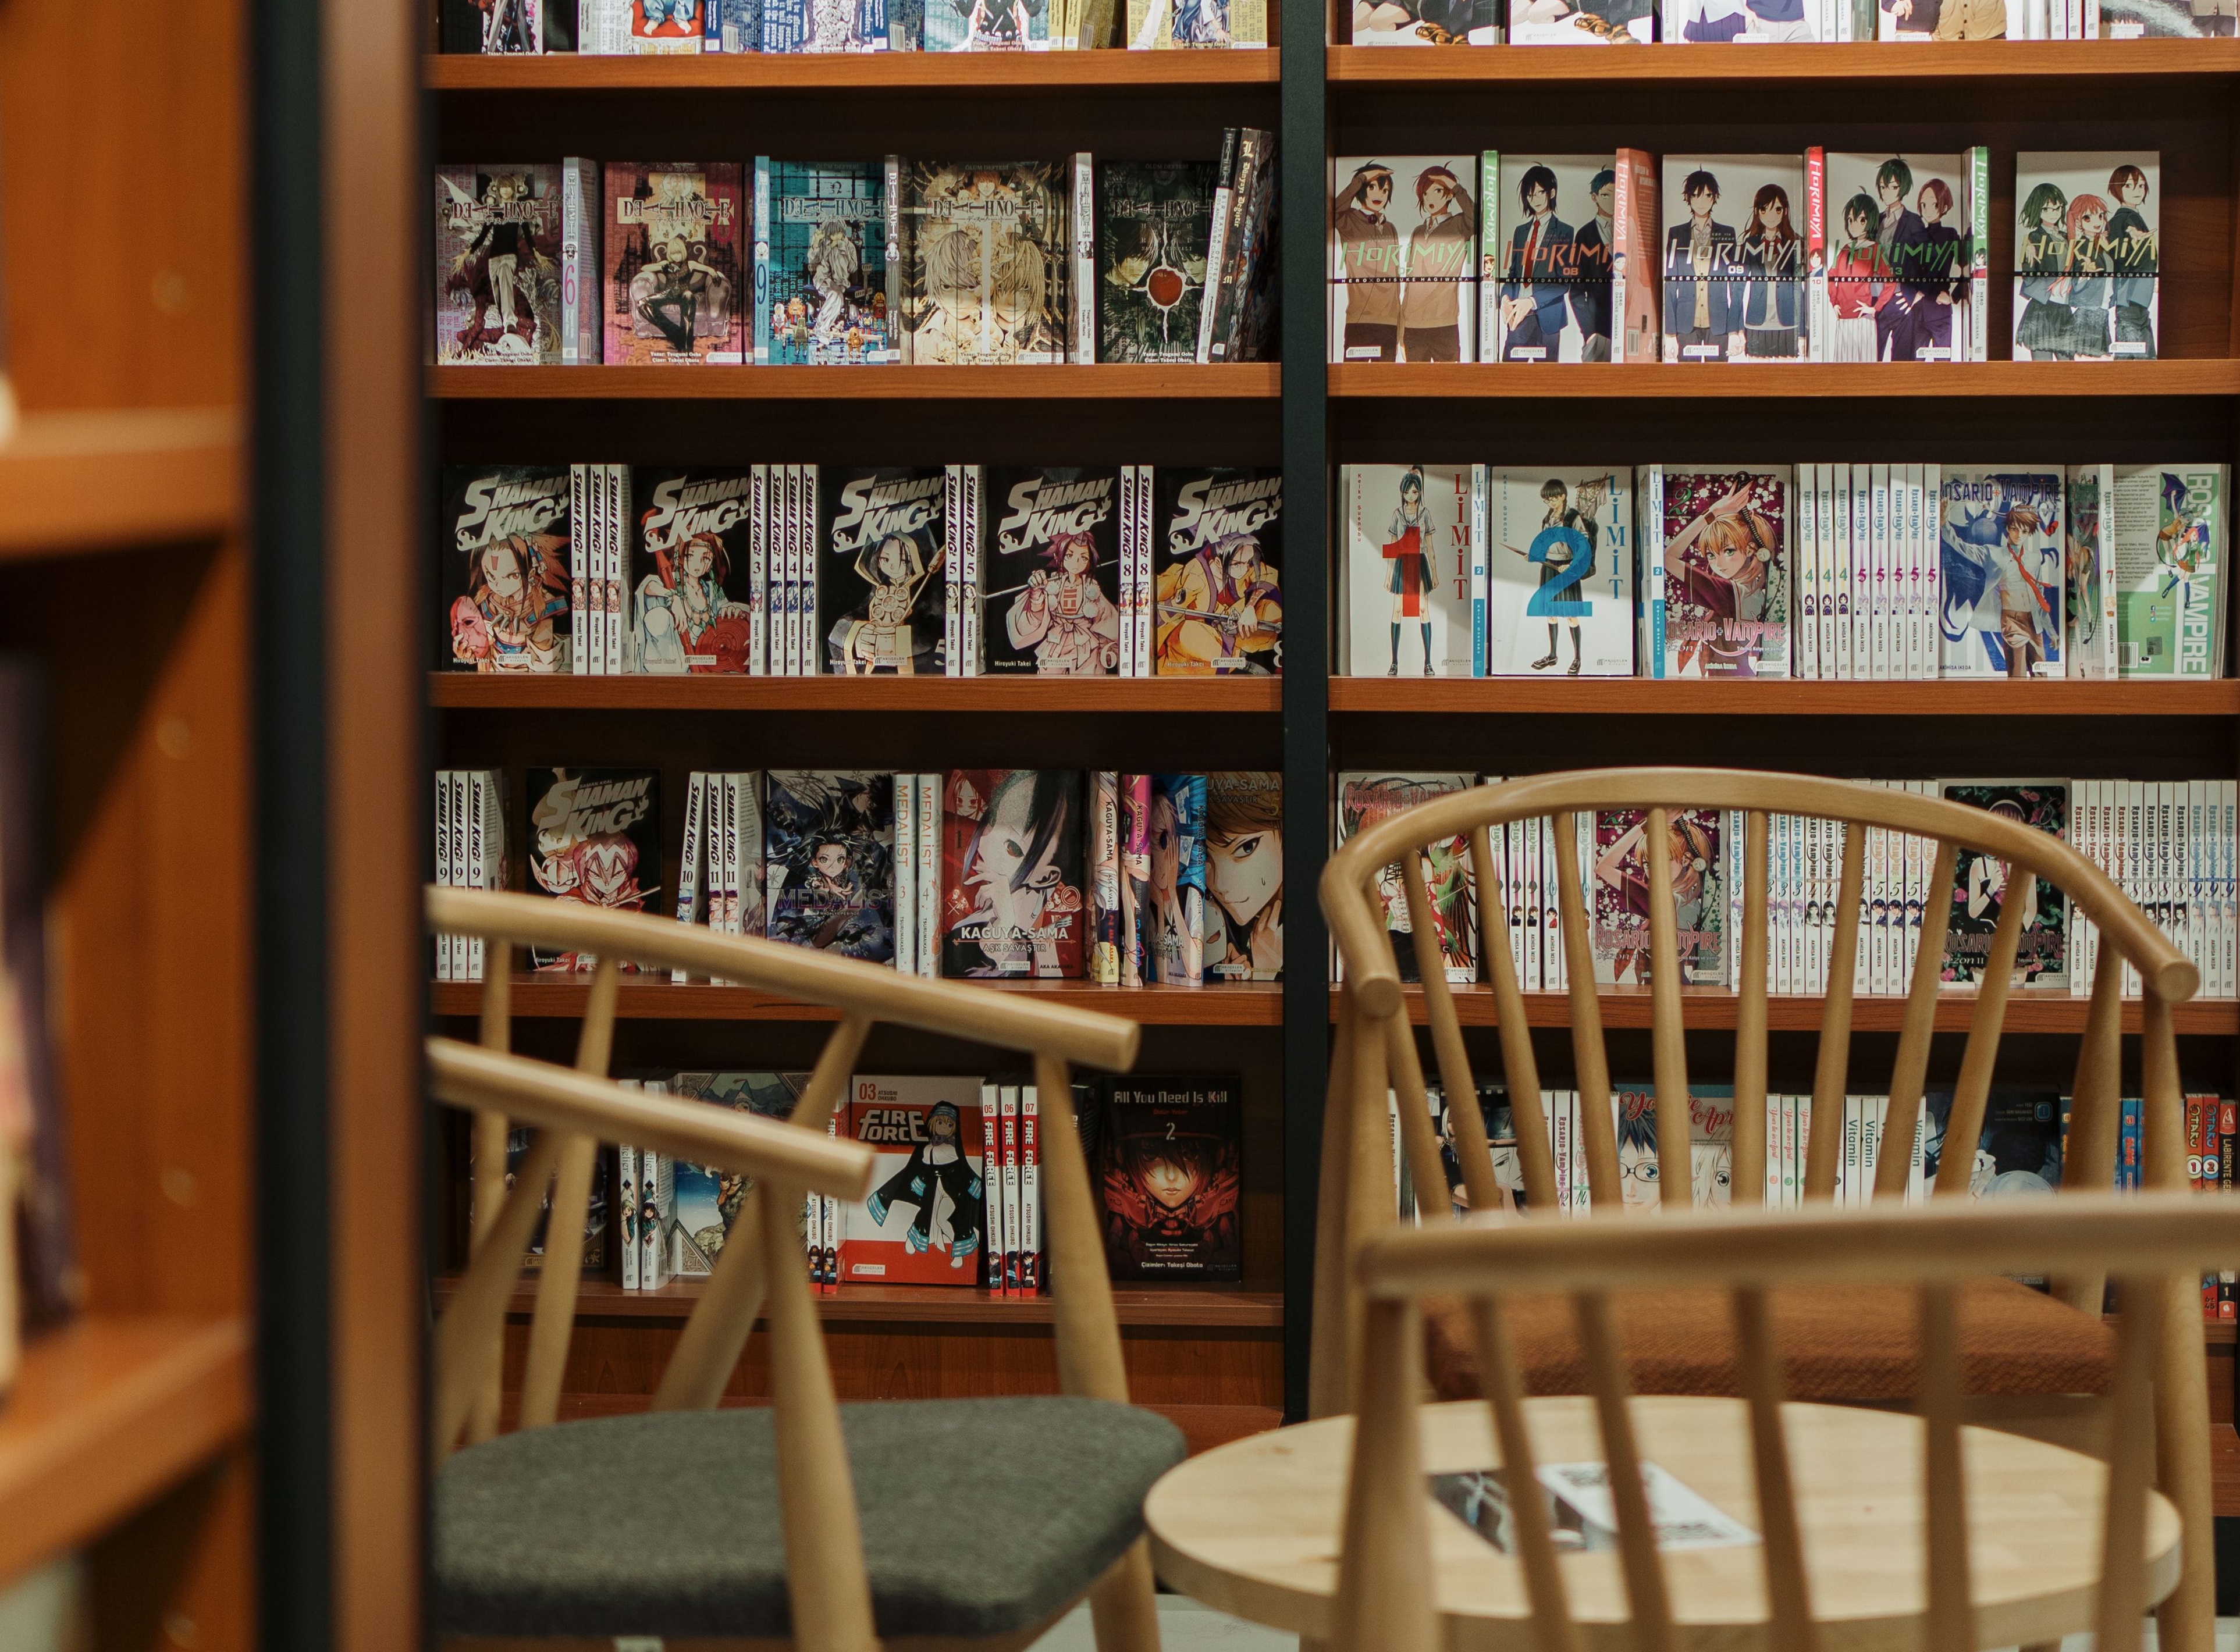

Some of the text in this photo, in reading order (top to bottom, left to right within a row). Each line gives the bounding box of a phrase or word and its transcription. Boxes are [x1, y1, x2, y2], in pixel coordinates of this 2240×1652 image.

[1562, 267, 1578, 276] 08
[1728, 265, 1744, 274] 09
[564, 264, 575, 305] 6
[756, 264, 767, 305] 9
[455, 474, 570, 535] SHAMAN
[831, 474, 945, 535] SHAMAN
[998, 475, 1115, 536] SHAMAN
[469, 496, 566, 547] KING
[657, 498, 750, 549] KING
[845, 497, 943, 549] KING
[1013, 498, 1109, 550] KING
[576, 559, 582, 571] 1
[753, 562, 761, 573] 3
[806, 562, 813, 574] 4
[967, 562, 975, 575] 5
[1123, 564, 1131, 576] 8
[1382, 526, 1420, 617] 1
[1527, 527, 1592, 617] 2
[1839, 568, 1847, 581] 4
[1858, 568, 1866, 582] 5
[2106, 570, 2114, 583] 7
[2182, 576, 2210, 673] VAMPIRE
[1207, 778, 1280, 792] UYA-SAMA
[536, 776, 652, 835] SHAMAN
[550, 799, 646, 848] KING
[1105, 802, 1114, 861] KAGUYA-SAMA
[456, 867, 463, 880] 9
[682, 870, 693, 883] 10
[727, 871, 735, 882] 11
[923, 888, 929, 900] 4
[1808, 883, 1818, 897] 4
[1874, 882, 1886, 896] 5
[2129, 883, 2141, 898] 8
[2206, 882, 2218, 897] 9
[961, 927, 1068, 939] KAGUYA-SAMA
[983, 944, 1046, 953] AŞK SAVAŞTIR
[859, 1083, 876, 1100] 03
[1114, 1091, 1228, 1103] All You Need Is Kill
[984, 1105, 993, 1113] 05
[1005, 1104, 1014, 1113] 06
[1025, 1103, 1034, 1112] 07
[1691, 1106, 1734, 1134] Apr
[1166, 1122, 1175, 1140] 2
[1848, 1120, 1858, 1166] Vitamin
[1865, 1121, 1875, 1167] Vitamin
[621, 1145, 630, 1173] telier
[985, 1121, 995, 1186] FIRE FORCE
[1025, 1120, 1033, 1185] FIRE FORCE
[2223, 1138, 2233, 1178] LABİRENTE
[2191, 1162, 2196, 1172] 1
[2207, 1162, 2215, 1172] 2
